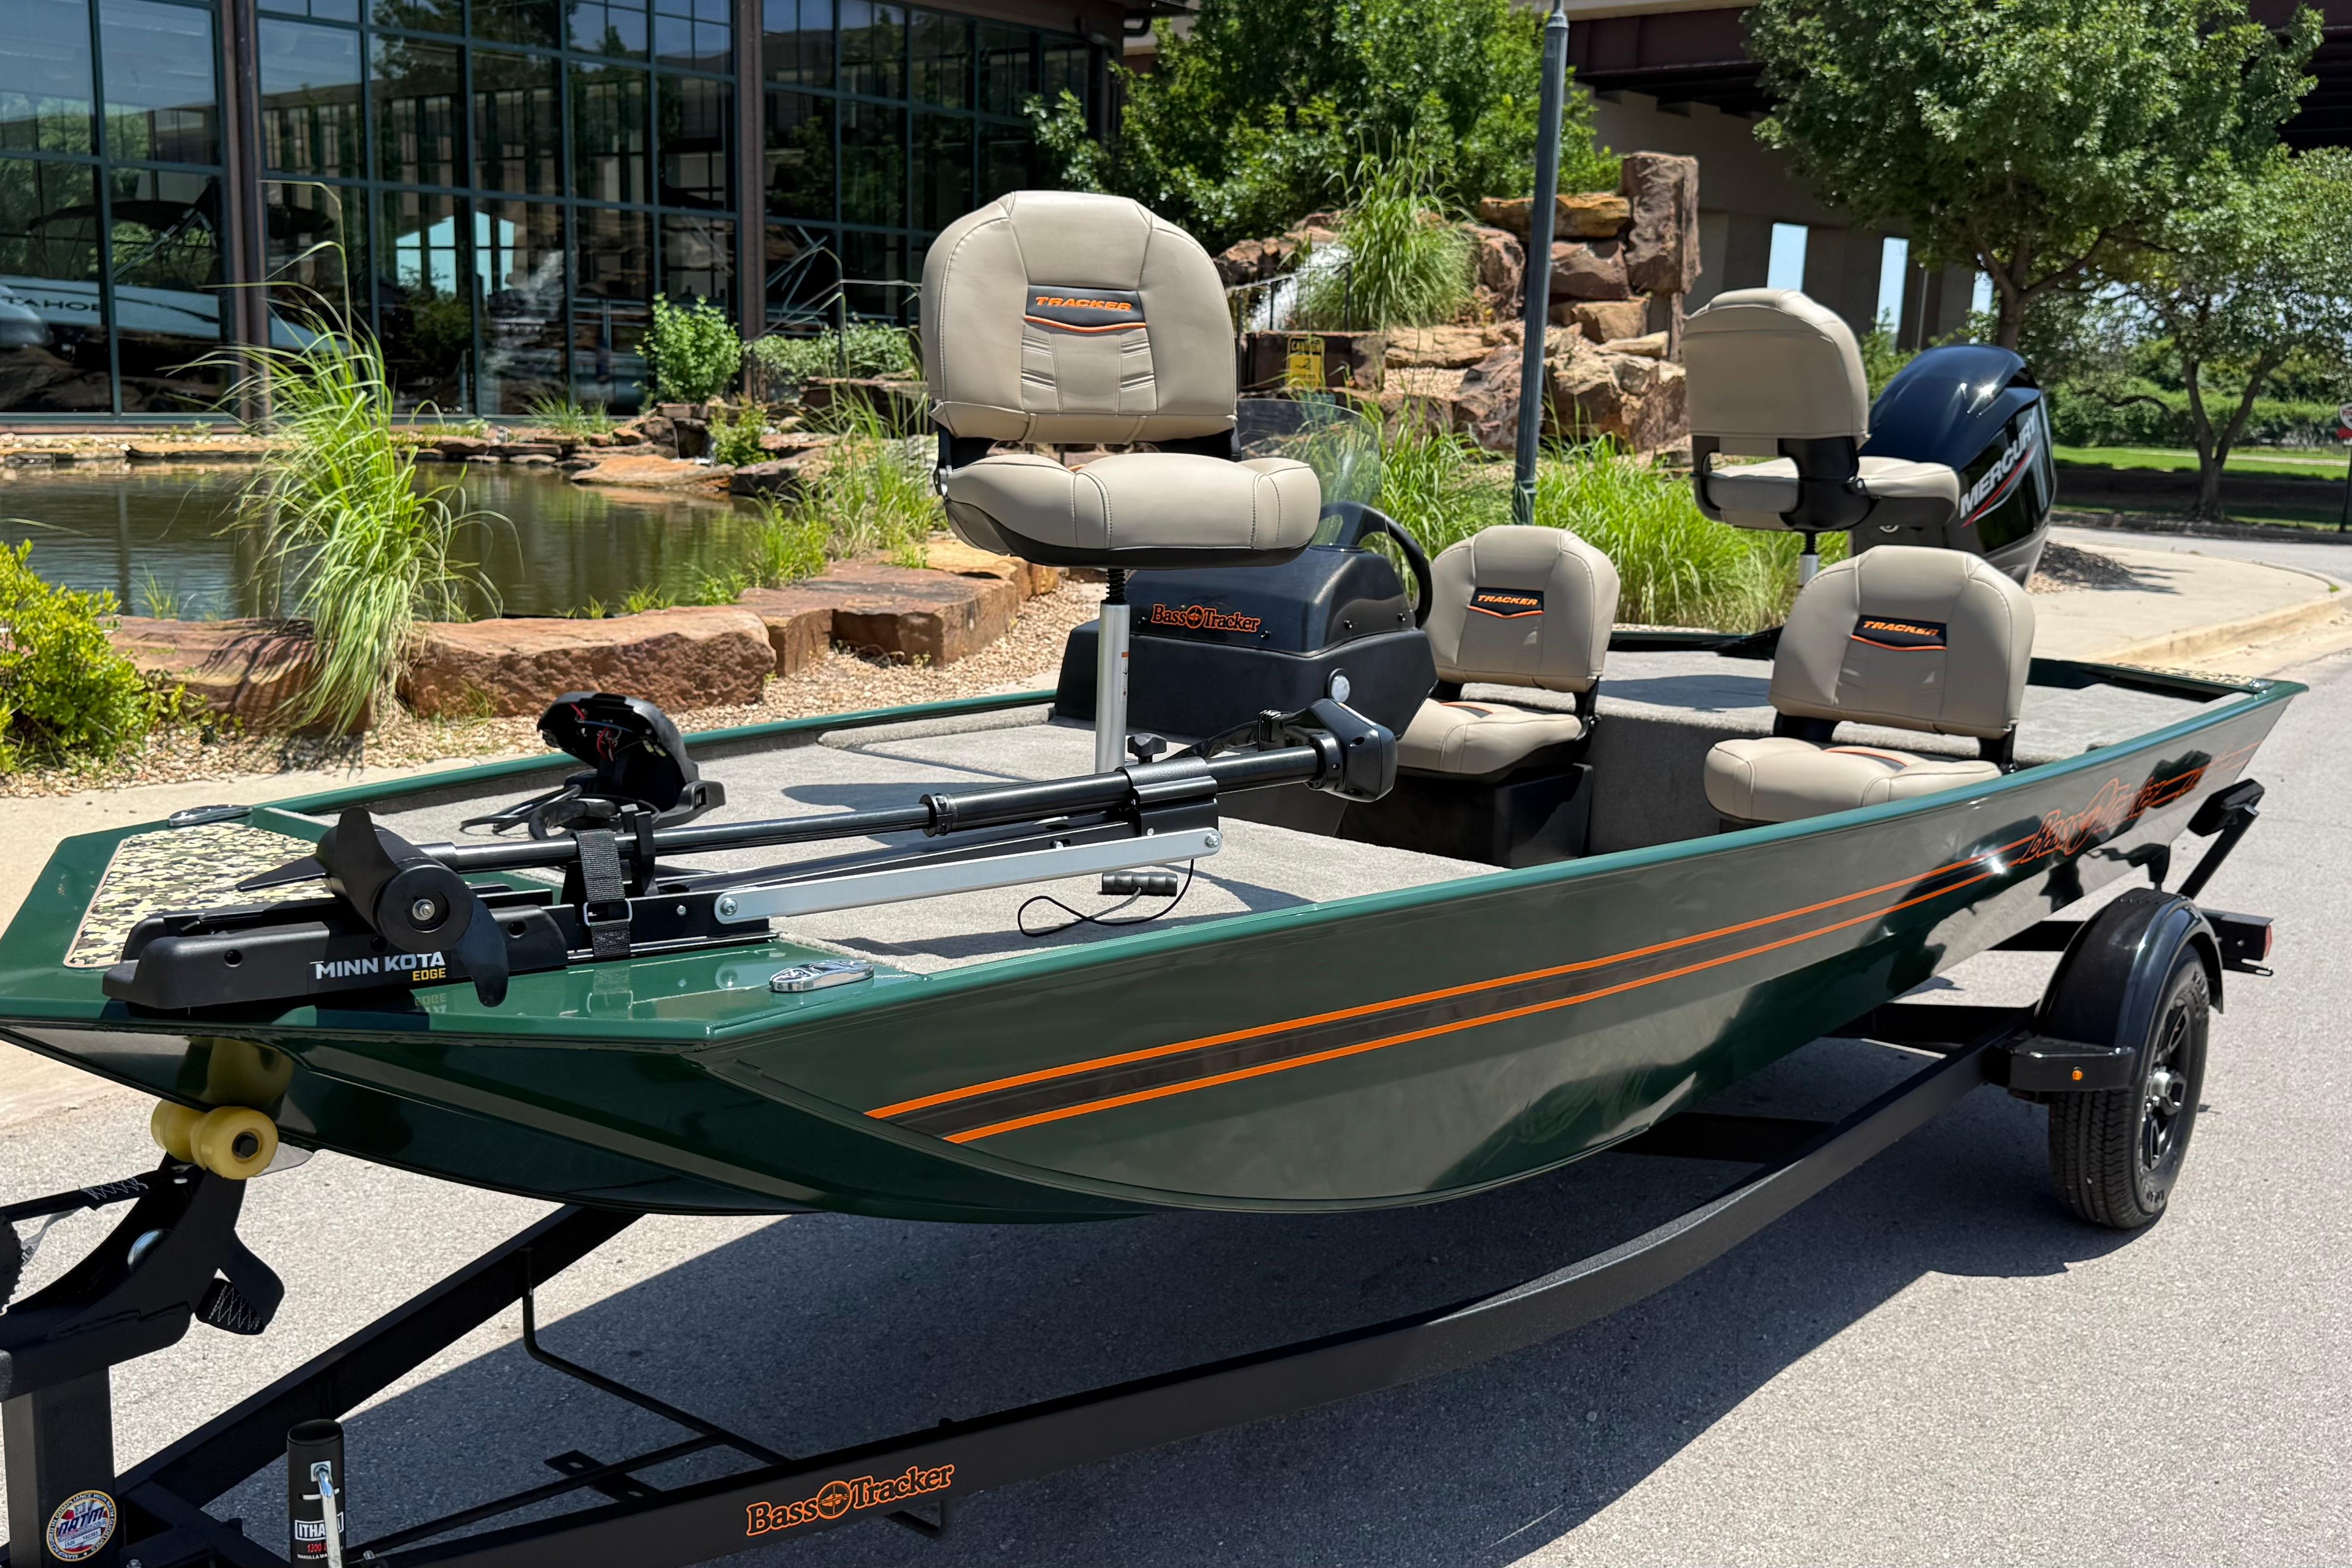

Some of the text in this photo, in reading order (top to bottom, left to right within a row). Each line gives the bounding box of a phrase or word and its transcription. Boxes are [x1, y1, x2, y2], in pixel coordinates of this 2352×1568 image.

[1035, 297, 1132, 312] TRACKER
[1960, 405, 2038, 519] MERCURY
[1478, 595, 1538, 606] TRACKER
[1151, 603, 1261, 632] Bass Tracker
[1863, 621, 1939, 636] TRACKER
[316, 951, 446, 979] MINN KOTA
[412, 967, 446, 981] EDGE
[746, 1464, 955, 1536] Bass Tracker
